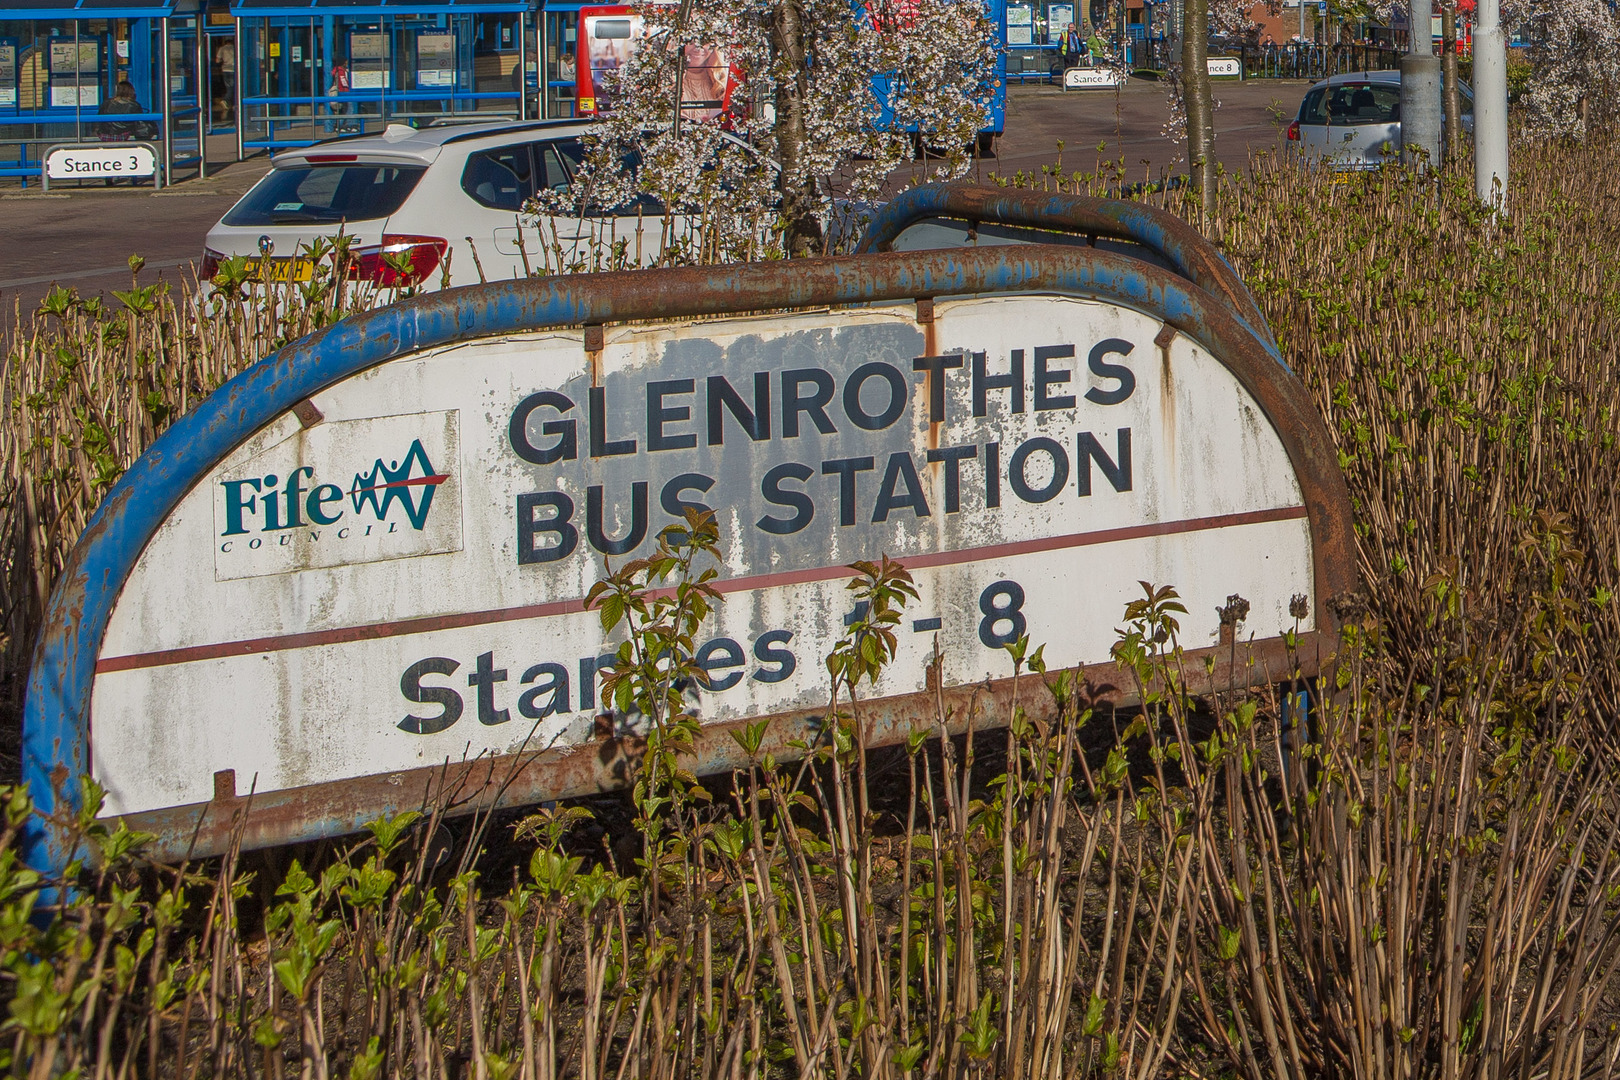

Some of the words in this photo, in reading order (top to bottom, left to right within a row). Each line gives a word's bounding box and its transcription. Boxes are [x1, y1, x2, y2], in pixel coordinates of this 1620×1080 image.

[1226, 63, 1232, 71] 8
[64, 157, 122, 172] Stance
[129, 156, 138, 170] 3
[508, 337, 1137, 465] GLENROTHES
[220, 466, 344, 536] Fife
[516, 472, 718, 566] BUS
[755, 427, 1134, 536] STATION
[221, 522, 398, 553] COUNCIL
[979, 579, 1027, 650] 8
